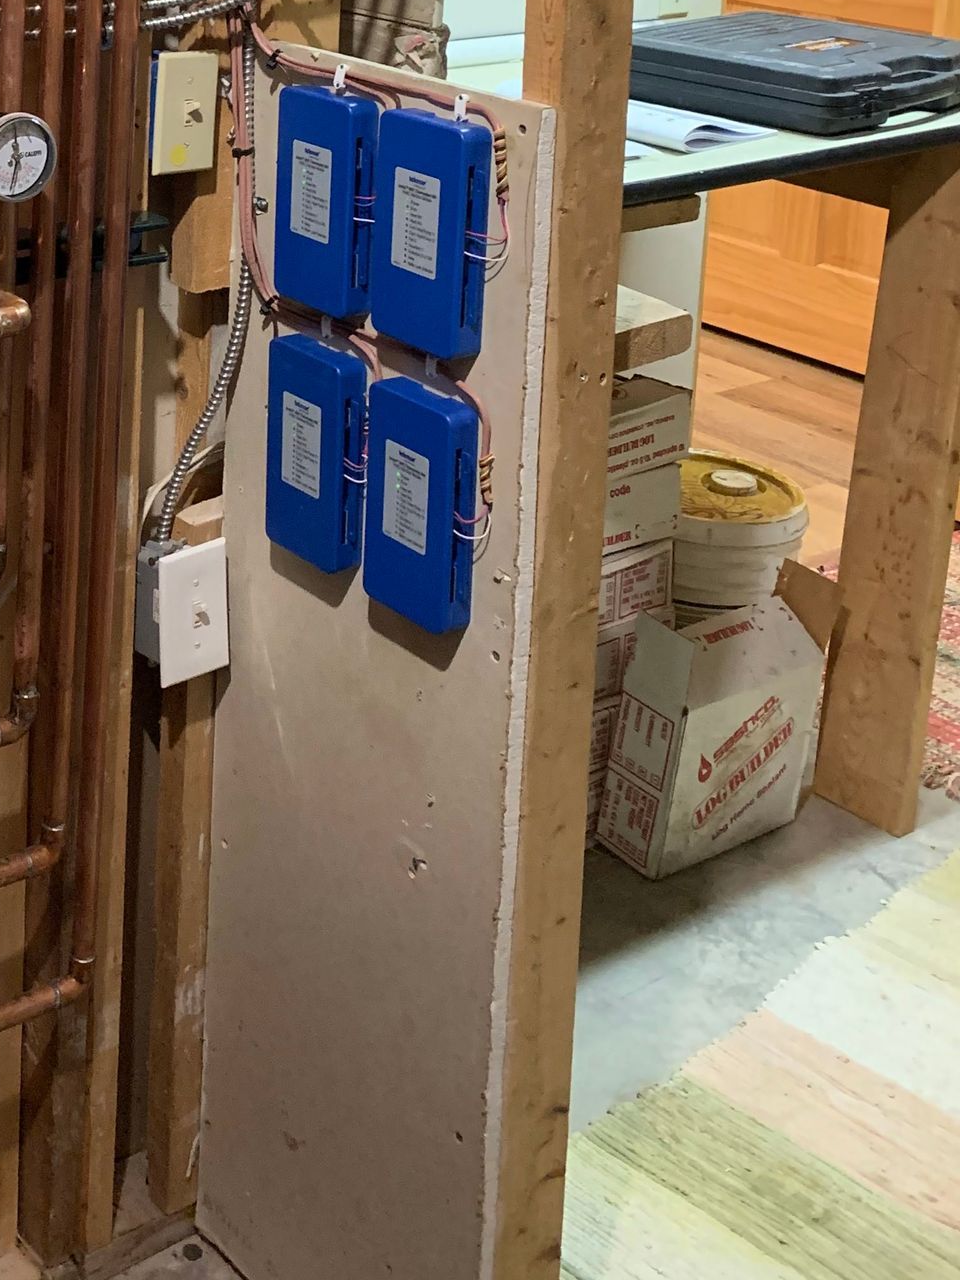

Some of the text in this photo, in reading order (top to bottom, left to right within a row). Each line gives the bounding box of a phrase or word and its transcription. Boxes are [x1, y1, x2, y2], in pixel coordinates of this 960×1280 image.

[610, 484, 631, 498] code
[694, 720, 793, 826] LOG BUILDER
